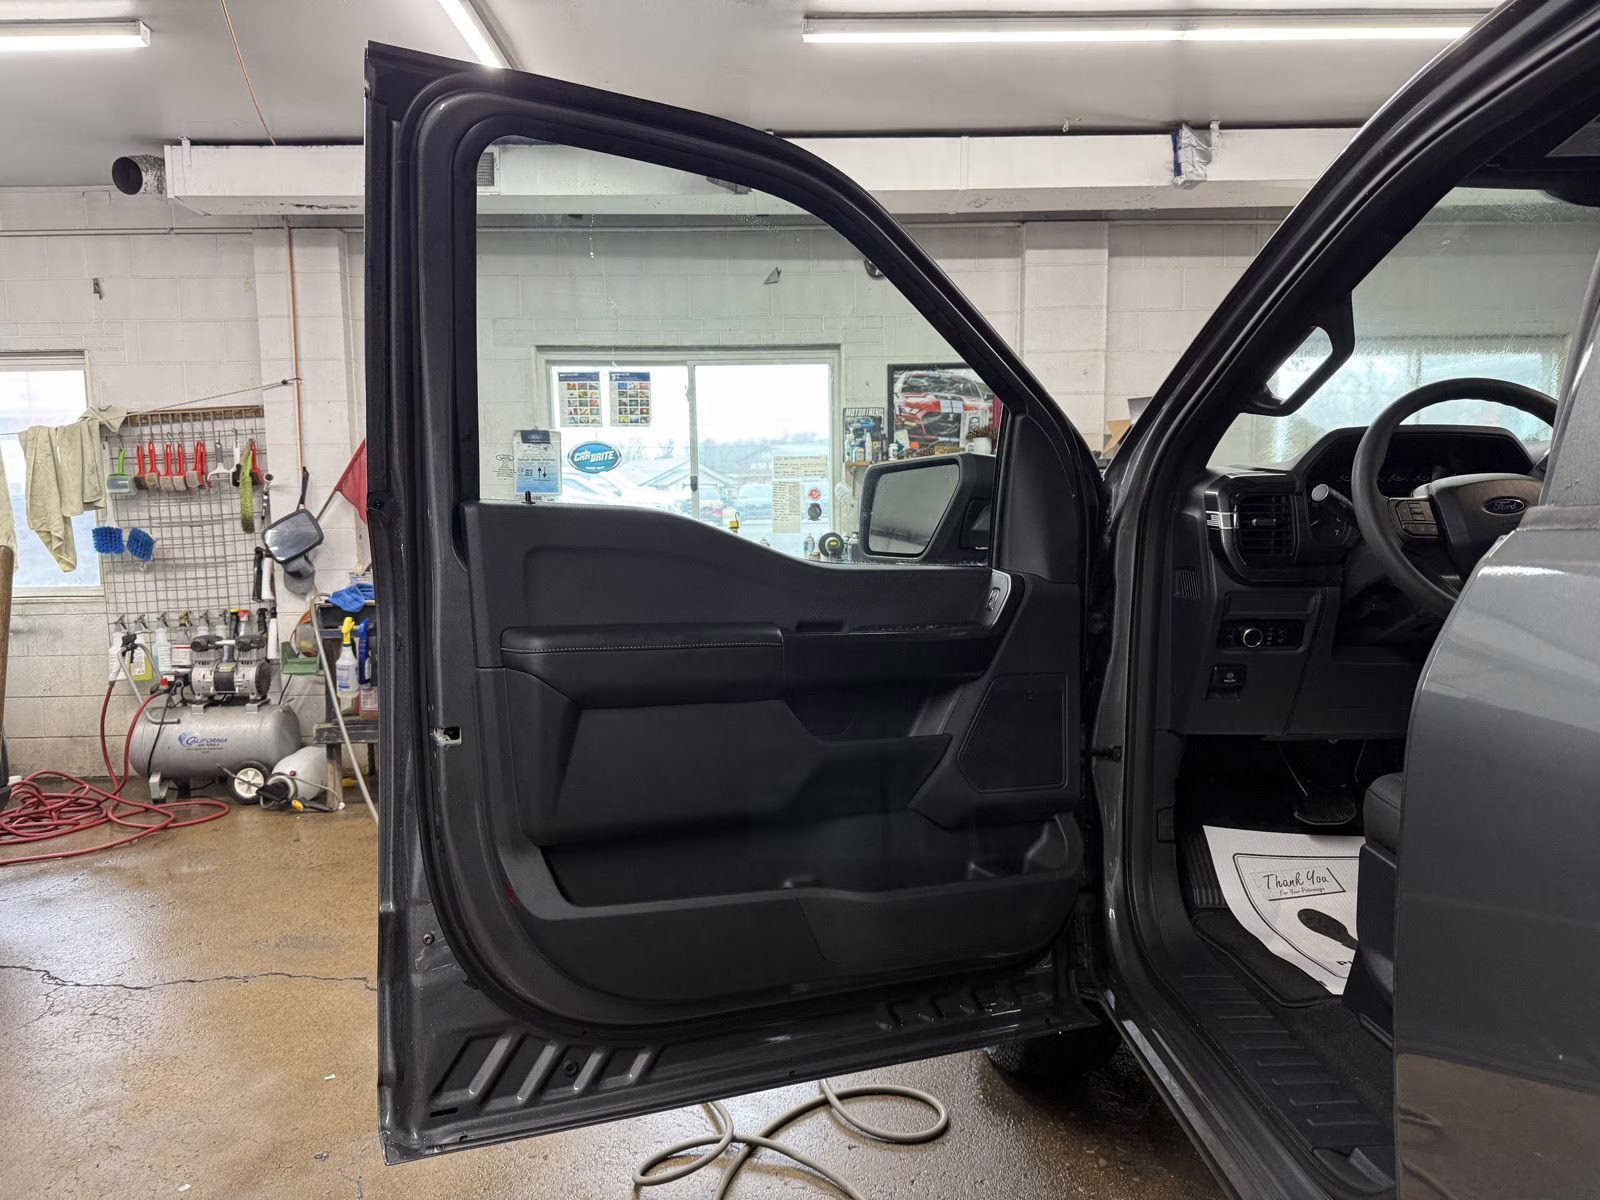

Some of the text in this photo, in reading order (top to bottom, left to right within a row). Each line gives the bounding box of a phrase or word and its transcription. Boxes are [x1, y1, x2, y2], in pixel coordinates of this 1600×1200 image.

[1493, 500, 1517, 510] Ford
[1262, 870, 1329, 890] Thank You
